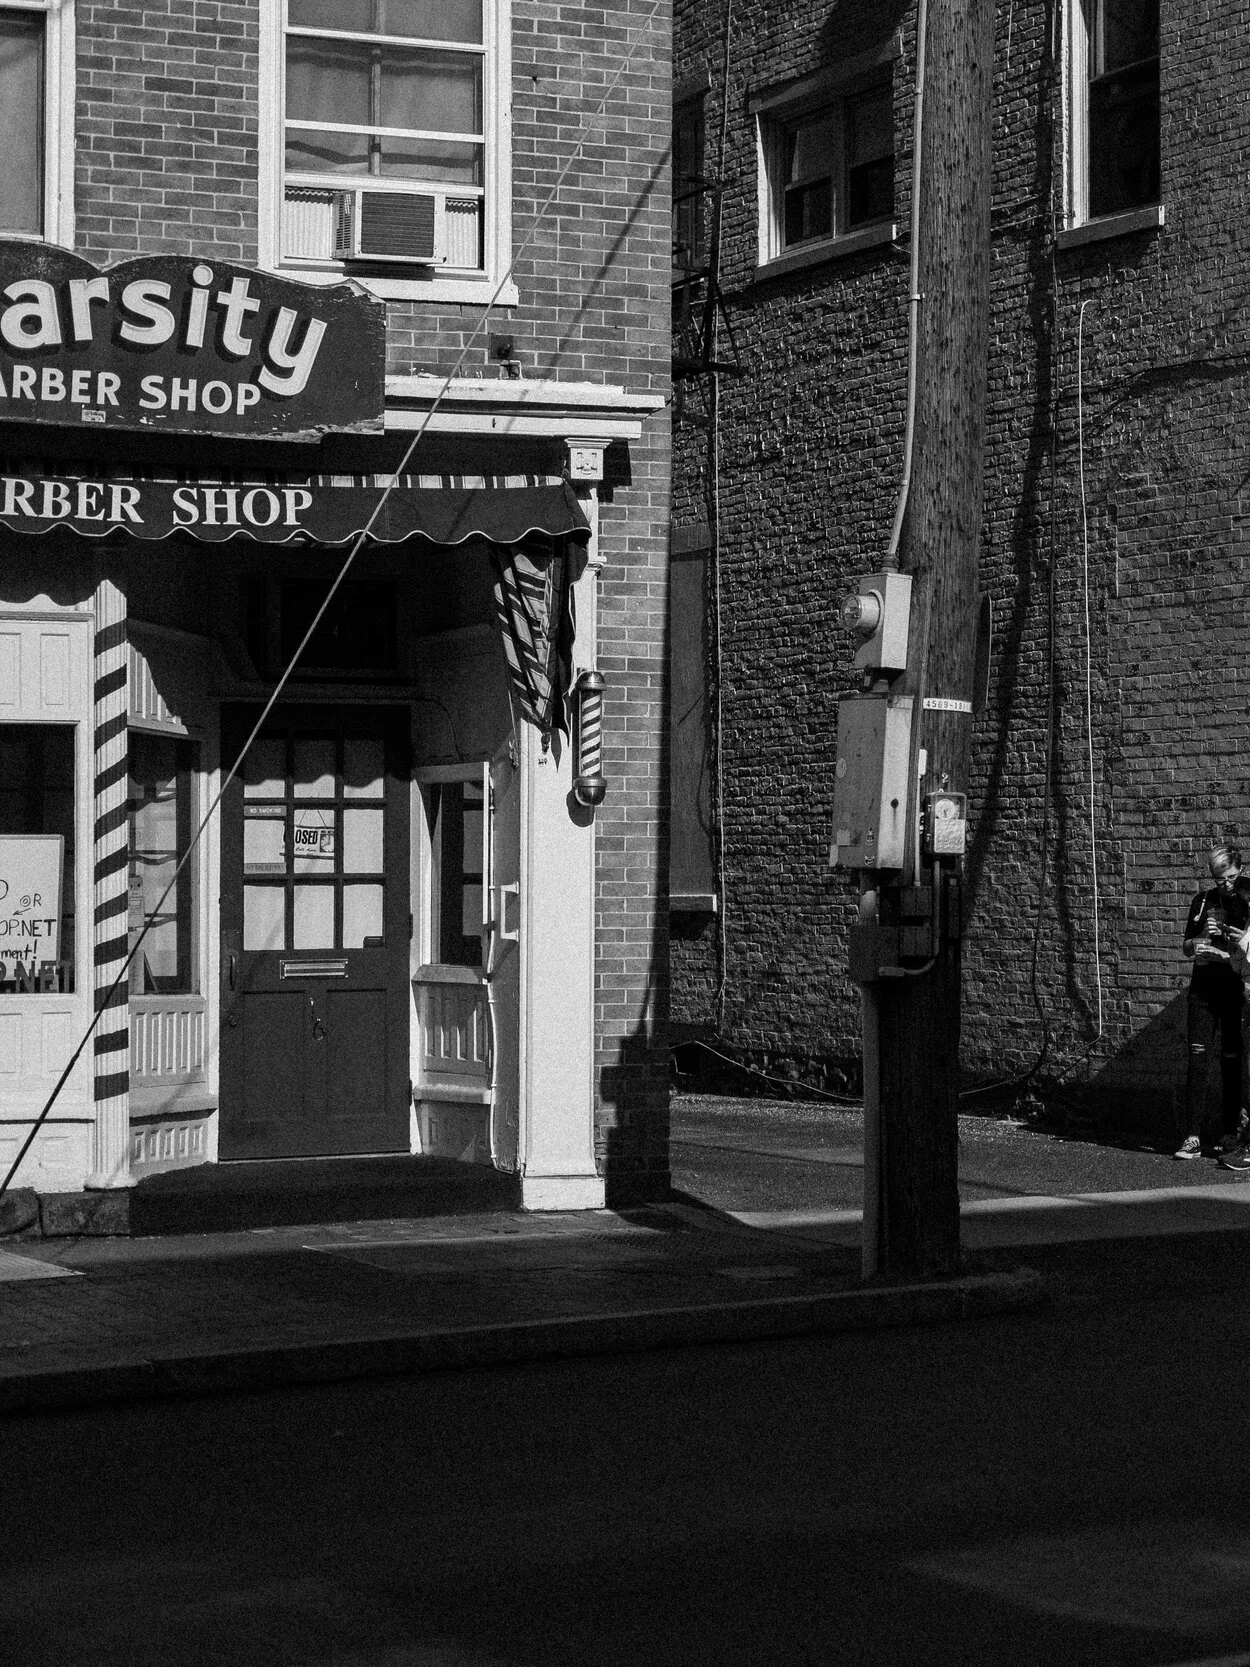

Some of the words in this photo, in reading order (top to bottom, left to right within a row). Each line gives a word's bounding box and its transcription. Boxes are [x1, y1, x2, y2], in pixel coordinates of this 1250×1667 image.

[0, 265, 328, 396] arsity
[139, 375, 261, 415] SHOP
[0, 477, 145, 523] RBER
[173, 487, 313, 526] SHOP
[295, 829, 319, 845] OSED
